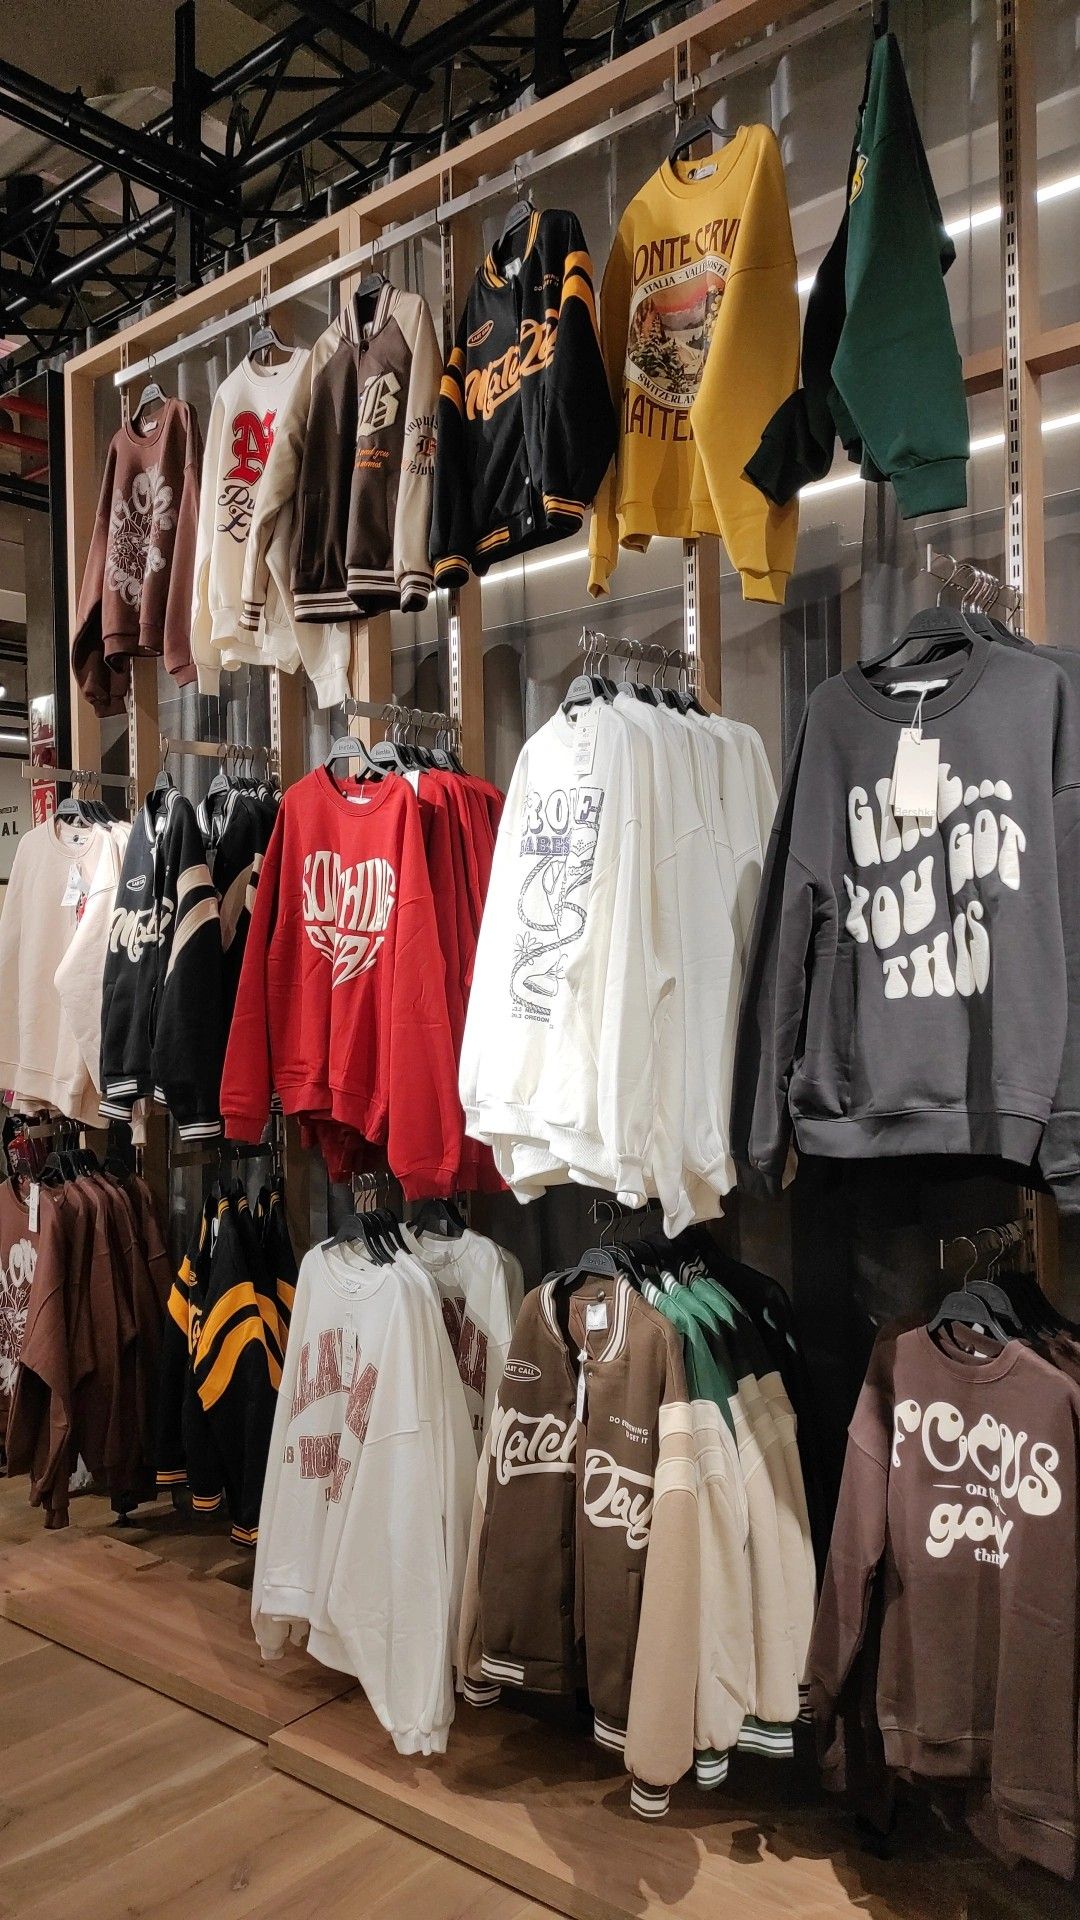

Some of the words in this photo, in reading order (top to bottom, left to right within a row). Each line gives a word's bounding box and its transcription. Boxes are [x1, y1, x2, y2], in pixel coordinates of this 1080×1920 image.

[632, 234, 692, 288] ONTE
[643, 276, 676, 295] ITALIA
[356, 372, 402, 444] B
[637, 372, 697, 405] SWITZERLAN
[843, 855, 936, 950] YOU
[949, 809, 1026, 896] GOT
[883, 900, 991, 1000] THIS
[609, 1415, 621, 1424] DO
[965, 1483, 988, 1498] on
